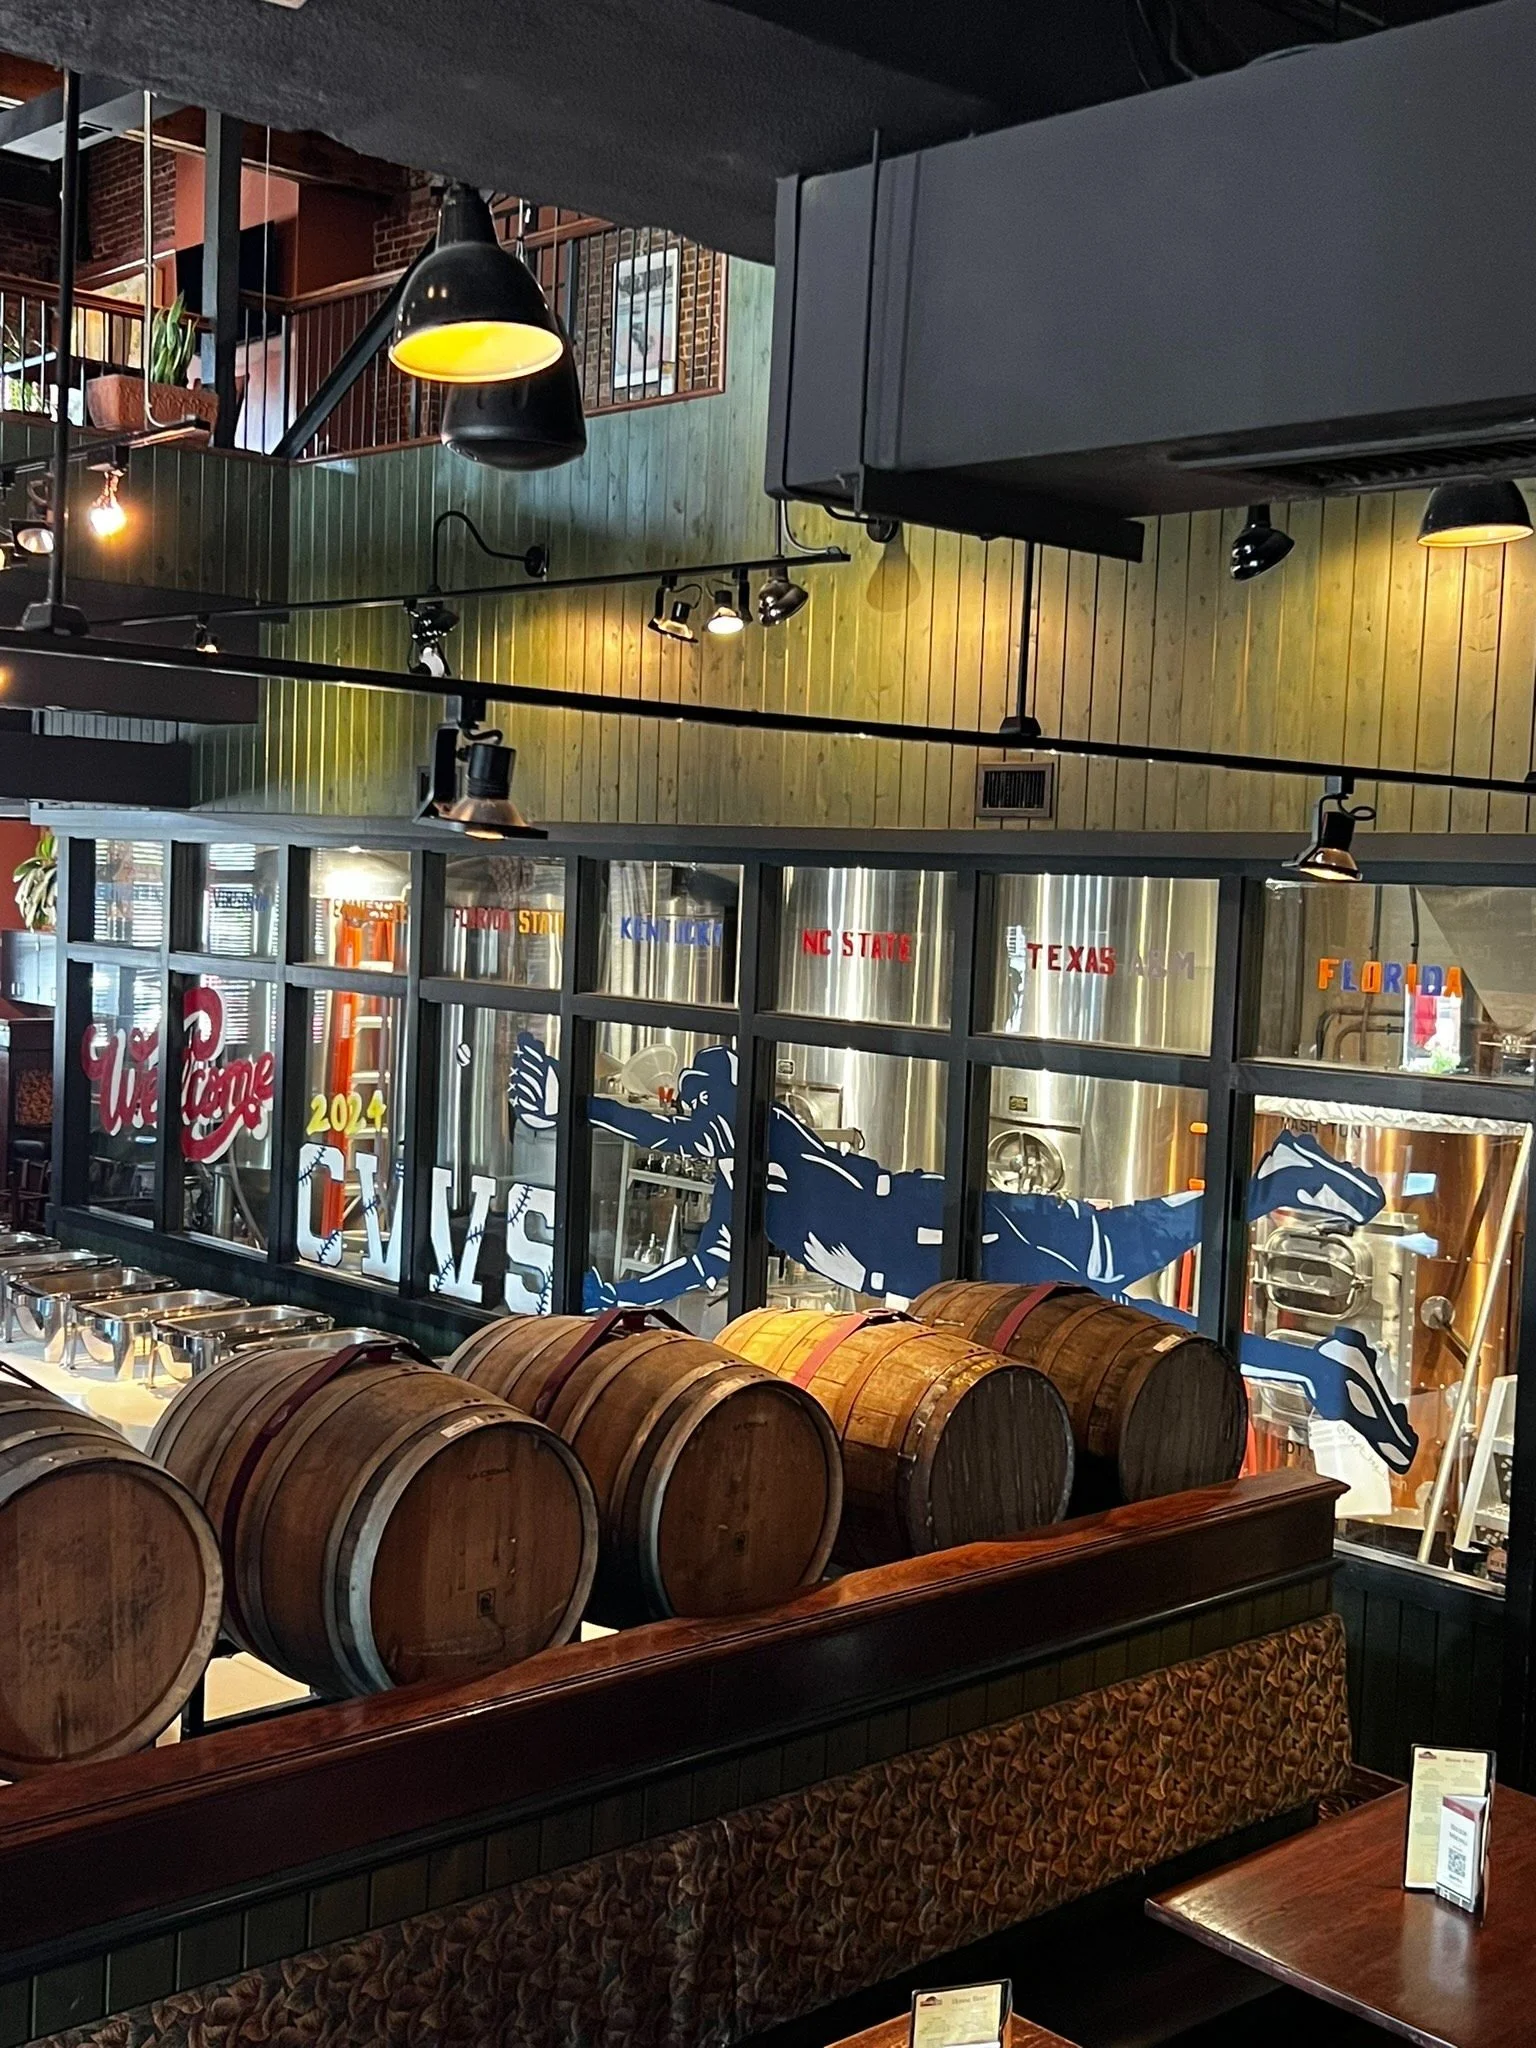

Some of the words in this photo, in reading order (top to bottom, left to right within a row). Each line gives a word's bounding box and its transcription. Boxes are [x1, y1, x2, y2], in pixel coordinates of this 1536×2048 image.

[803, 929, 832, 956] NC
[841, 931, 913, 963] STATE
[1026, 943, 1117, 976] TEXAS
[1317, 957, 1464, 998] FLORIDA
[305, 1090, 388, 1136] 2024
[1329, 1122, 1361, 1139] TUN
